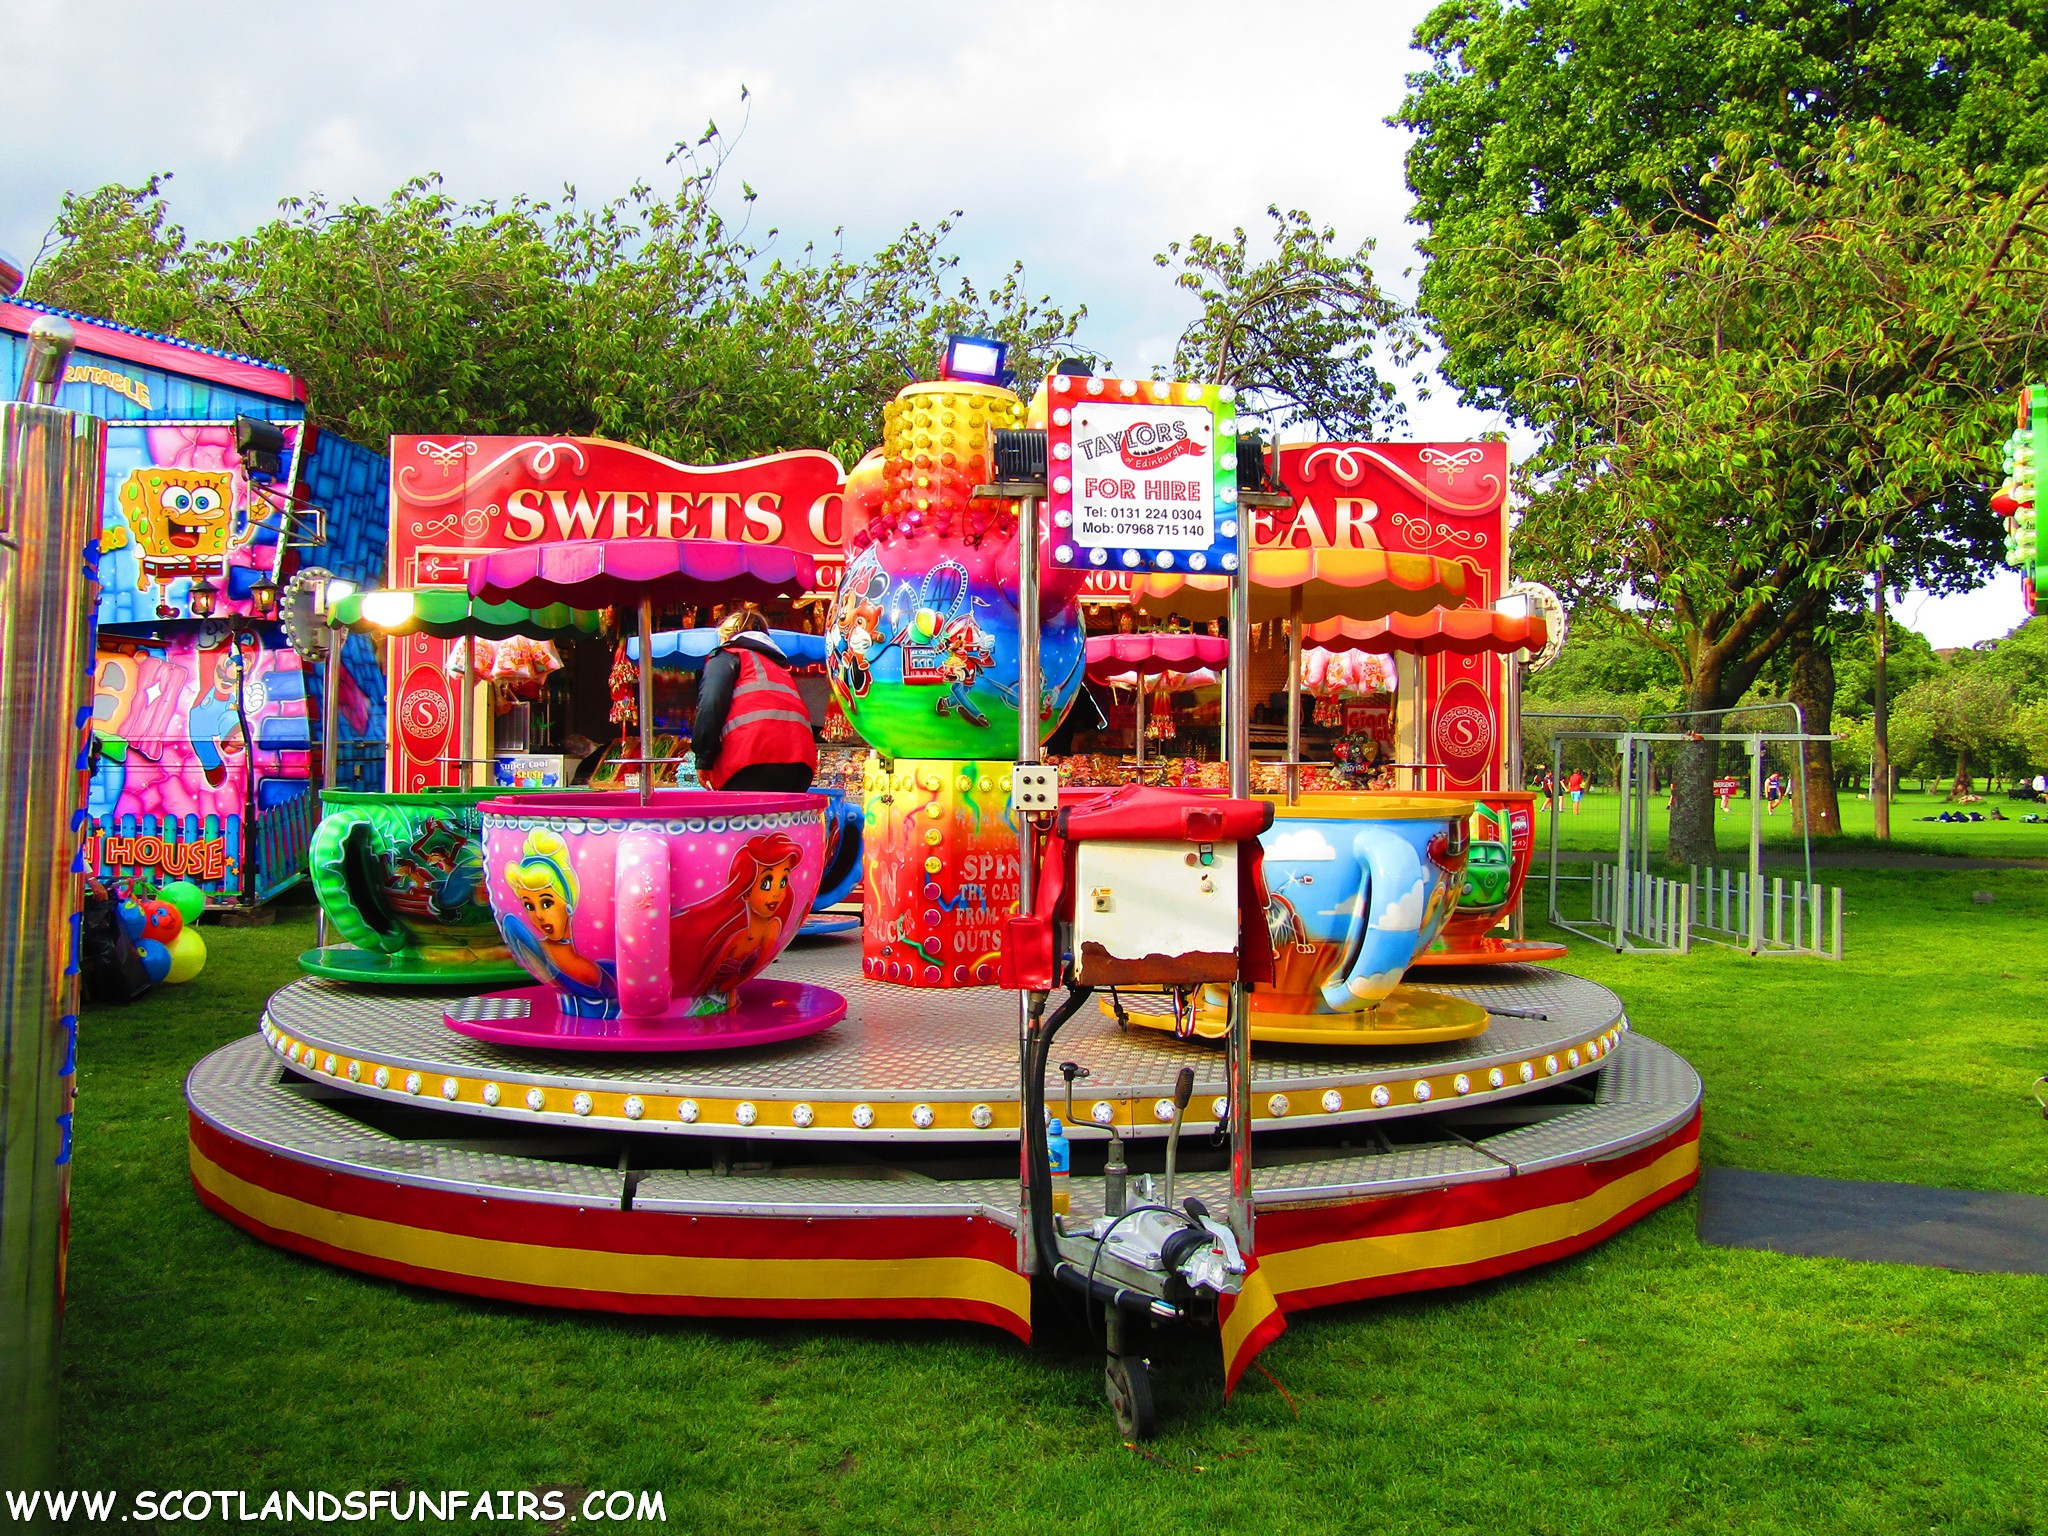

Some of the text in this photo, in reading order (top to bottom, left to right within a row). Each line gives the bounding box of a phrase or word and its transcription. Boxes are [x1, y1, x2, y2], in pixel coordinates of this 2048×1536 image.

[1078, 421, 1188, 460] TAYLORS
[1125, 444, 1184, 468] of Edinburgh
[1085, 478, 1200, 501] FOR HIRE
[504, 489, 783, 543] SWEETS
[1084, 506, 1202, 520] Tel: 0131 224 0304
[1082, 522, 1204, 536] Mob: 07968 715 140
[105, 836, 224, 880] HOUSE
[964, 854, 1020, 880] SPIN
[959, 883, 987, 900] THE
[863, 903, 915, 943] SAUCER
[955, 907, 998, 925] FROM
[953, 929, 1001, 953] OUTS
